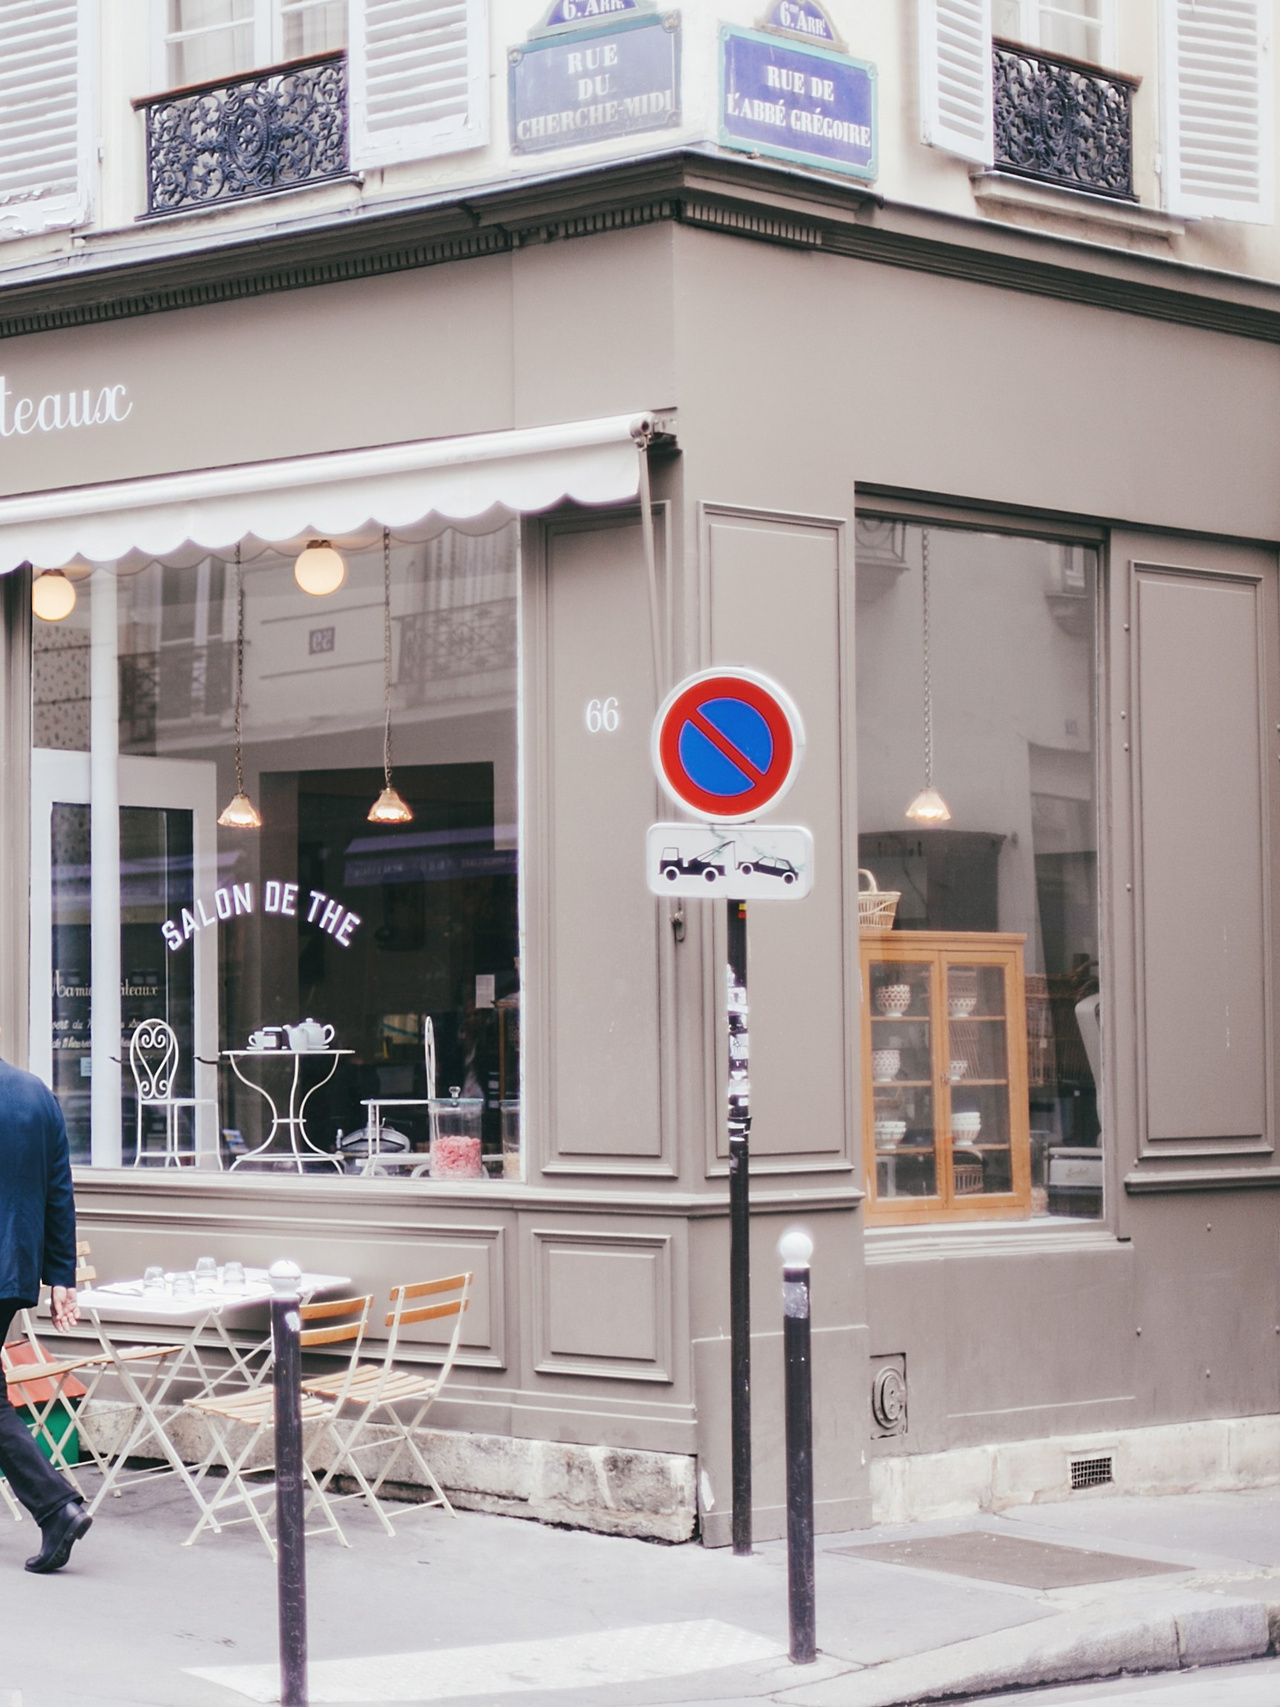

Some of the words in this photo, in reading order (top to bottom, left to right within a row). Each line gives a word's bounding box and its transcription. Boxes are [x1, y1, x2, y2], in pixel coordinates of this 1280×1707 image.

[567, 44, 618, 74] RUE
[578, 74, 611, 100] DU
[767, 65, 805, 95] RUE
[811, 76, 835, 102] DE
[517, 89, 673, 140] CHERCHE-MIDI
[726, 92, 787, 127] L'ABBÉ
[790, 107, 871, 148] GRÉGOIRE
[585, 697, 619, 733] 66
[161, 882, 252, 951] SALON
[265, 881, 299, 916] DE
[306, 890, 361, 947] THE
